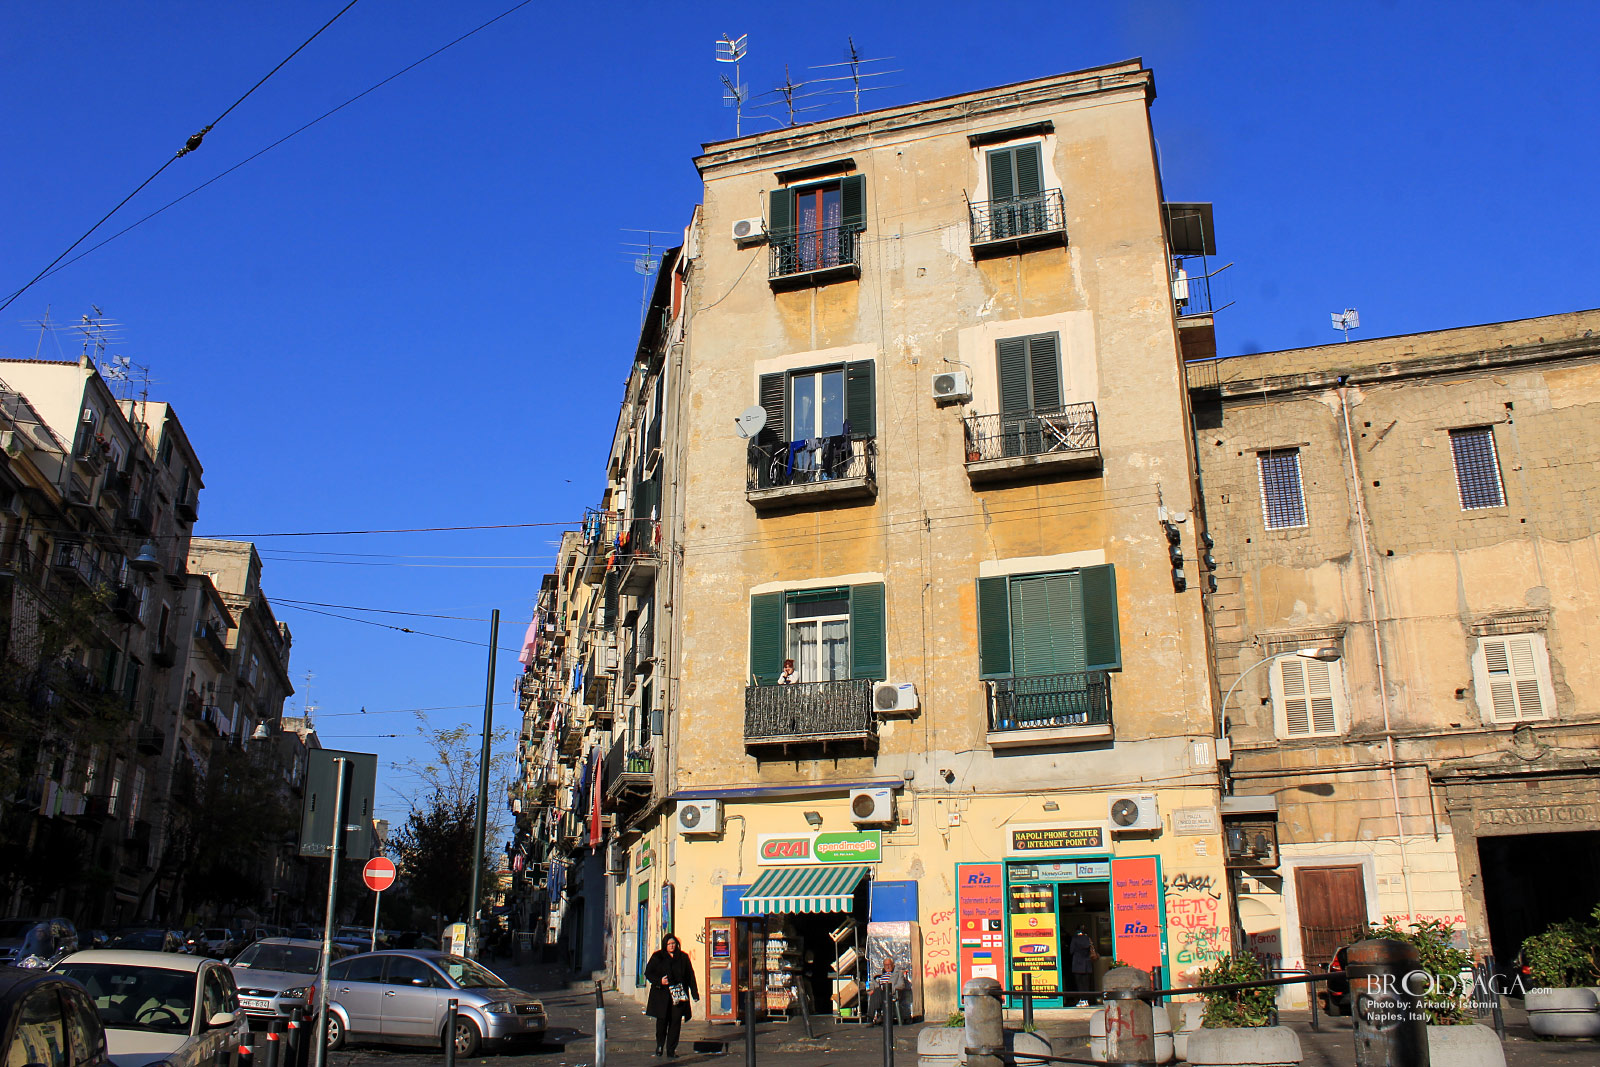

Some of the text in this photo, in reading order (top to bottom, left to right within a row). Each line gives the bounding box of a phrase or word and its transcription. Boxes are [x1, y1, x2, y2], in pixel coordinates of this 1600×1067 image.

[1016, 829, 1099, 841] NAPOLI PHONE CENTER
[764, 841, 809, 858] CRAI
[818, 840, 877, 854] spendimeglio
[1027, 838, 1088, 849] INTERNET POINT
[968, 871, 991, 884] Ria
[1013, 891, 1053, 899] WESTERN
[1019, 901, 1047, 909] UNION
[1124, 920, 1148, 934] Ria
[1034, 945, 1048, 953] TIM
